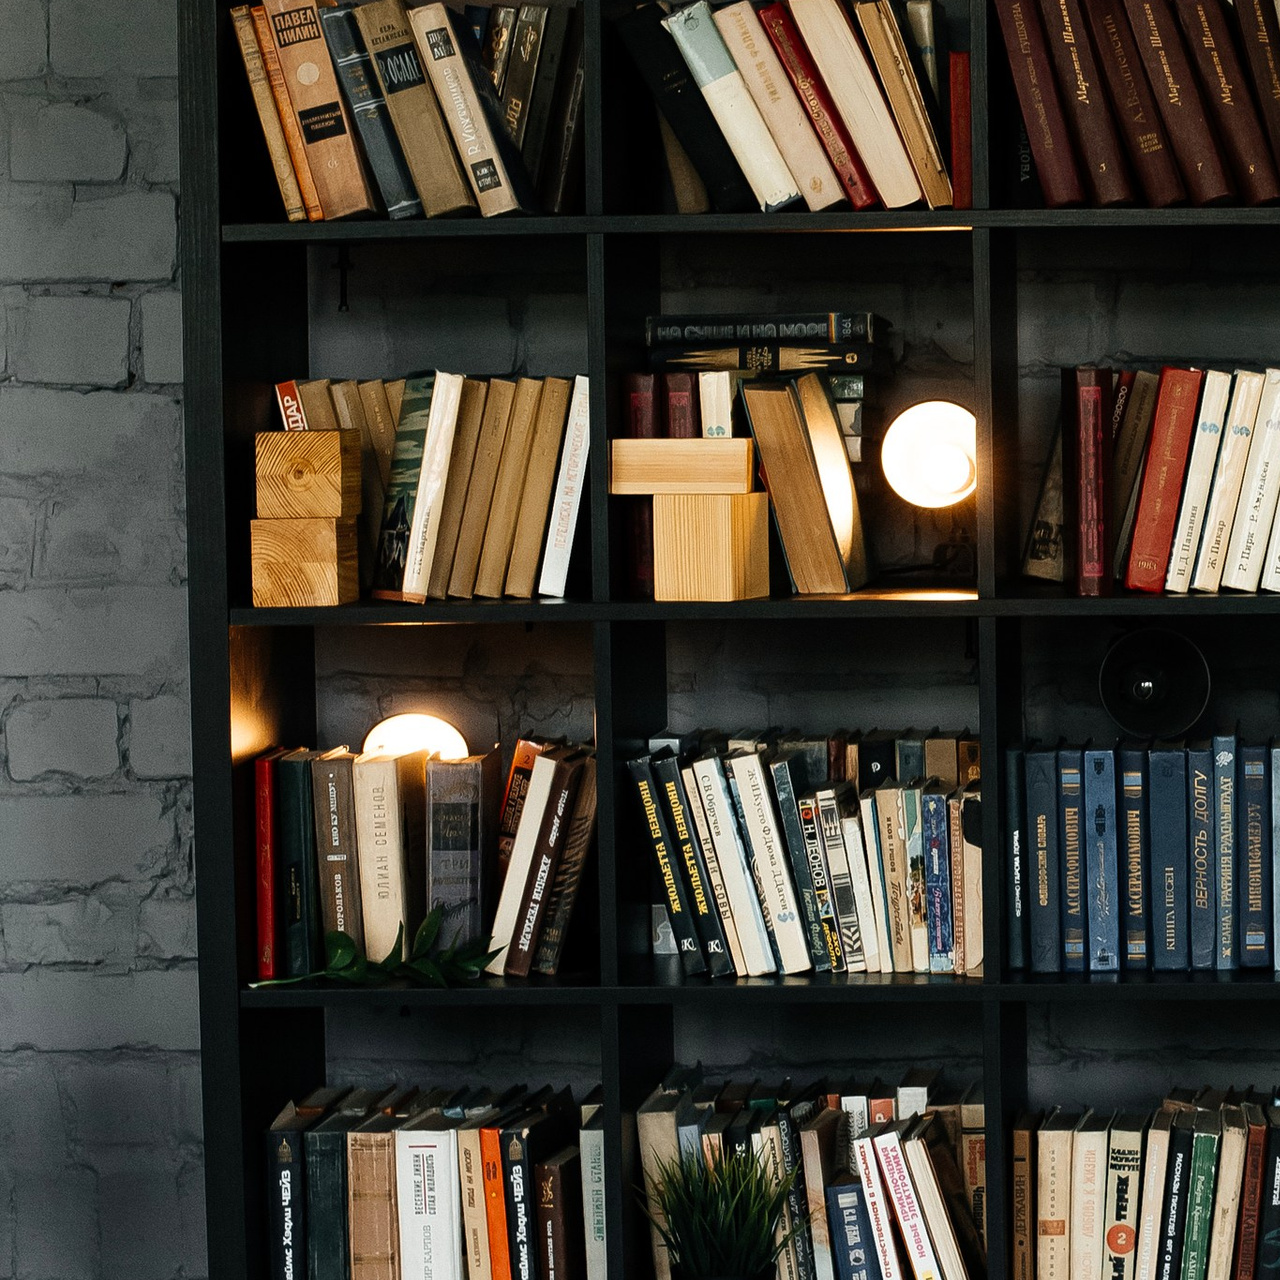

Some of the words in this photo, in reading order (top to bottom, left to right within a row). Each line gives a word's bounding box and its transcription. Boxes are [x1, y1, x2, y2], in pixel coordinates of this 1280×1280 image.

[274, 12, 316, 29] ПАВЕЛ
[278, 26, 319, 45] НИЛИН
[1010, 1, 1032, 55] ПУШКИНА
[1142, 2, 1163, 48] Шагинян
[1195, 3, 1216, 49] Шагинян
[1069, 45, 1091, 105] Мариэтта
[1103, 14, 1142, 107] Василевский
[1158, 50, 1181, 106] Мариэтта
[1210, 50, 1235, 106] Мариэтта
[779, 322, 828, 338] МОРЕ
[562, 485, 577, 497] НА
[553, 500, 574, 550] ПЕРЕПИСКА
[1181, 505, 1199, 553] Папанин
[1210, 519, 1227, 555] Пикар
[372, 785, 388, 846] СЕМЕНОВ
[637, 779, 662, 839] БЕНЦОНИ
[665, 780, 690, 840] БЕНЦОНИ
[1194, 770, 1209, 823] ДОЛГУ
[1220, 776, 1233, 854] РУДОЛЬШТАДТ
[802, 824, 816, 838] Н.
[1036, 814, 1047, 848] СЛОВАРЬ
[376, 854, 390, 900] ЮЛИАН
[530, 853, 553, 902] ДЖЕННИ
[656, 841, 682, 914] ЖЮЛЬЕТТА
[682, 842, 709, 916] ЖЮЛЬЕТТА
[806, 839, 826, 888] ЛЕОНОВ
[1036, 849, 1048, 907] ФИЛОСОФСКИЙ
[1064, 806, 1081, 916] А.С.СЕРАФИМОВИЧ
[1126, 808, 1143, 918] А.С.СЕРАФИМОВИЧ
[1194, 829, 1209, 910] ВЕРНОСТЬ
[1246, 801, 1262, 912] А.С.СЕРАФИМОВИЧ
[333, 873, 345, 932] КОРОЛЬКОВ
[711, 883, 731, 922] СОВЫ
[1164, 866, 1175, 907] ПЕСЕН
[1220, 855, 1232, 908] ГРАФИНЯ
[516, 900, 540, 953] ГЕРХАРДТ
[821, 921, 838, 969] ДЕФОЛТА
[830, 930, 842, 957] ЭХО
[1165, 909, 1176, 951] КНИГА
[1220, 913, 1232, 944] САНД
[279, 1169, 292, 1207] ЧЕЙЗ
[510, 1164, 525, 1203] ЧЕЙЗ
[857, 1143, 875, 1190] письмах
[880, 1145, 912, 1223] ПРИКЛЮЧЕНИЯ
[889, 1144, 919, 1221] ЭЛЕКТРОНИКА
[1084, 1149, 1097, 1186] ЖИЗНИ
[1172, 1152, 1183, 1194] РАССКАЗЫ
[412, 1179, 424, 1216] ВЕСЕННИЕ
[867, 1190, 877, 1199] в
[1015, 1174, 1028, 1237] ДЕРЖАВИН
[1083, 1187, 1095, 1196] К
[1114, 1173, 1130, 1222] ТЕРЕК
[281, 1206, 294, 1247] Хэдли
[515, 1202, 529, 1243] Хэдли
[1082, 1199, 1096, 1239] ЛЮБОВЬ
[1116, 1232, 1127, 1245] 2
[1167, 1194, 1179, 1237] ПИСАТЕЛЕЙ
[422, 1225, 433, 1264] КАРПОВ
[868, 1200, 892, 1278] Отечественная
[908, 1222, 927, 1259] НОВЫЕ
[1165, 1238, 1174, 1254] ФРГ
[1165, 1254, 1172, 1262] О
